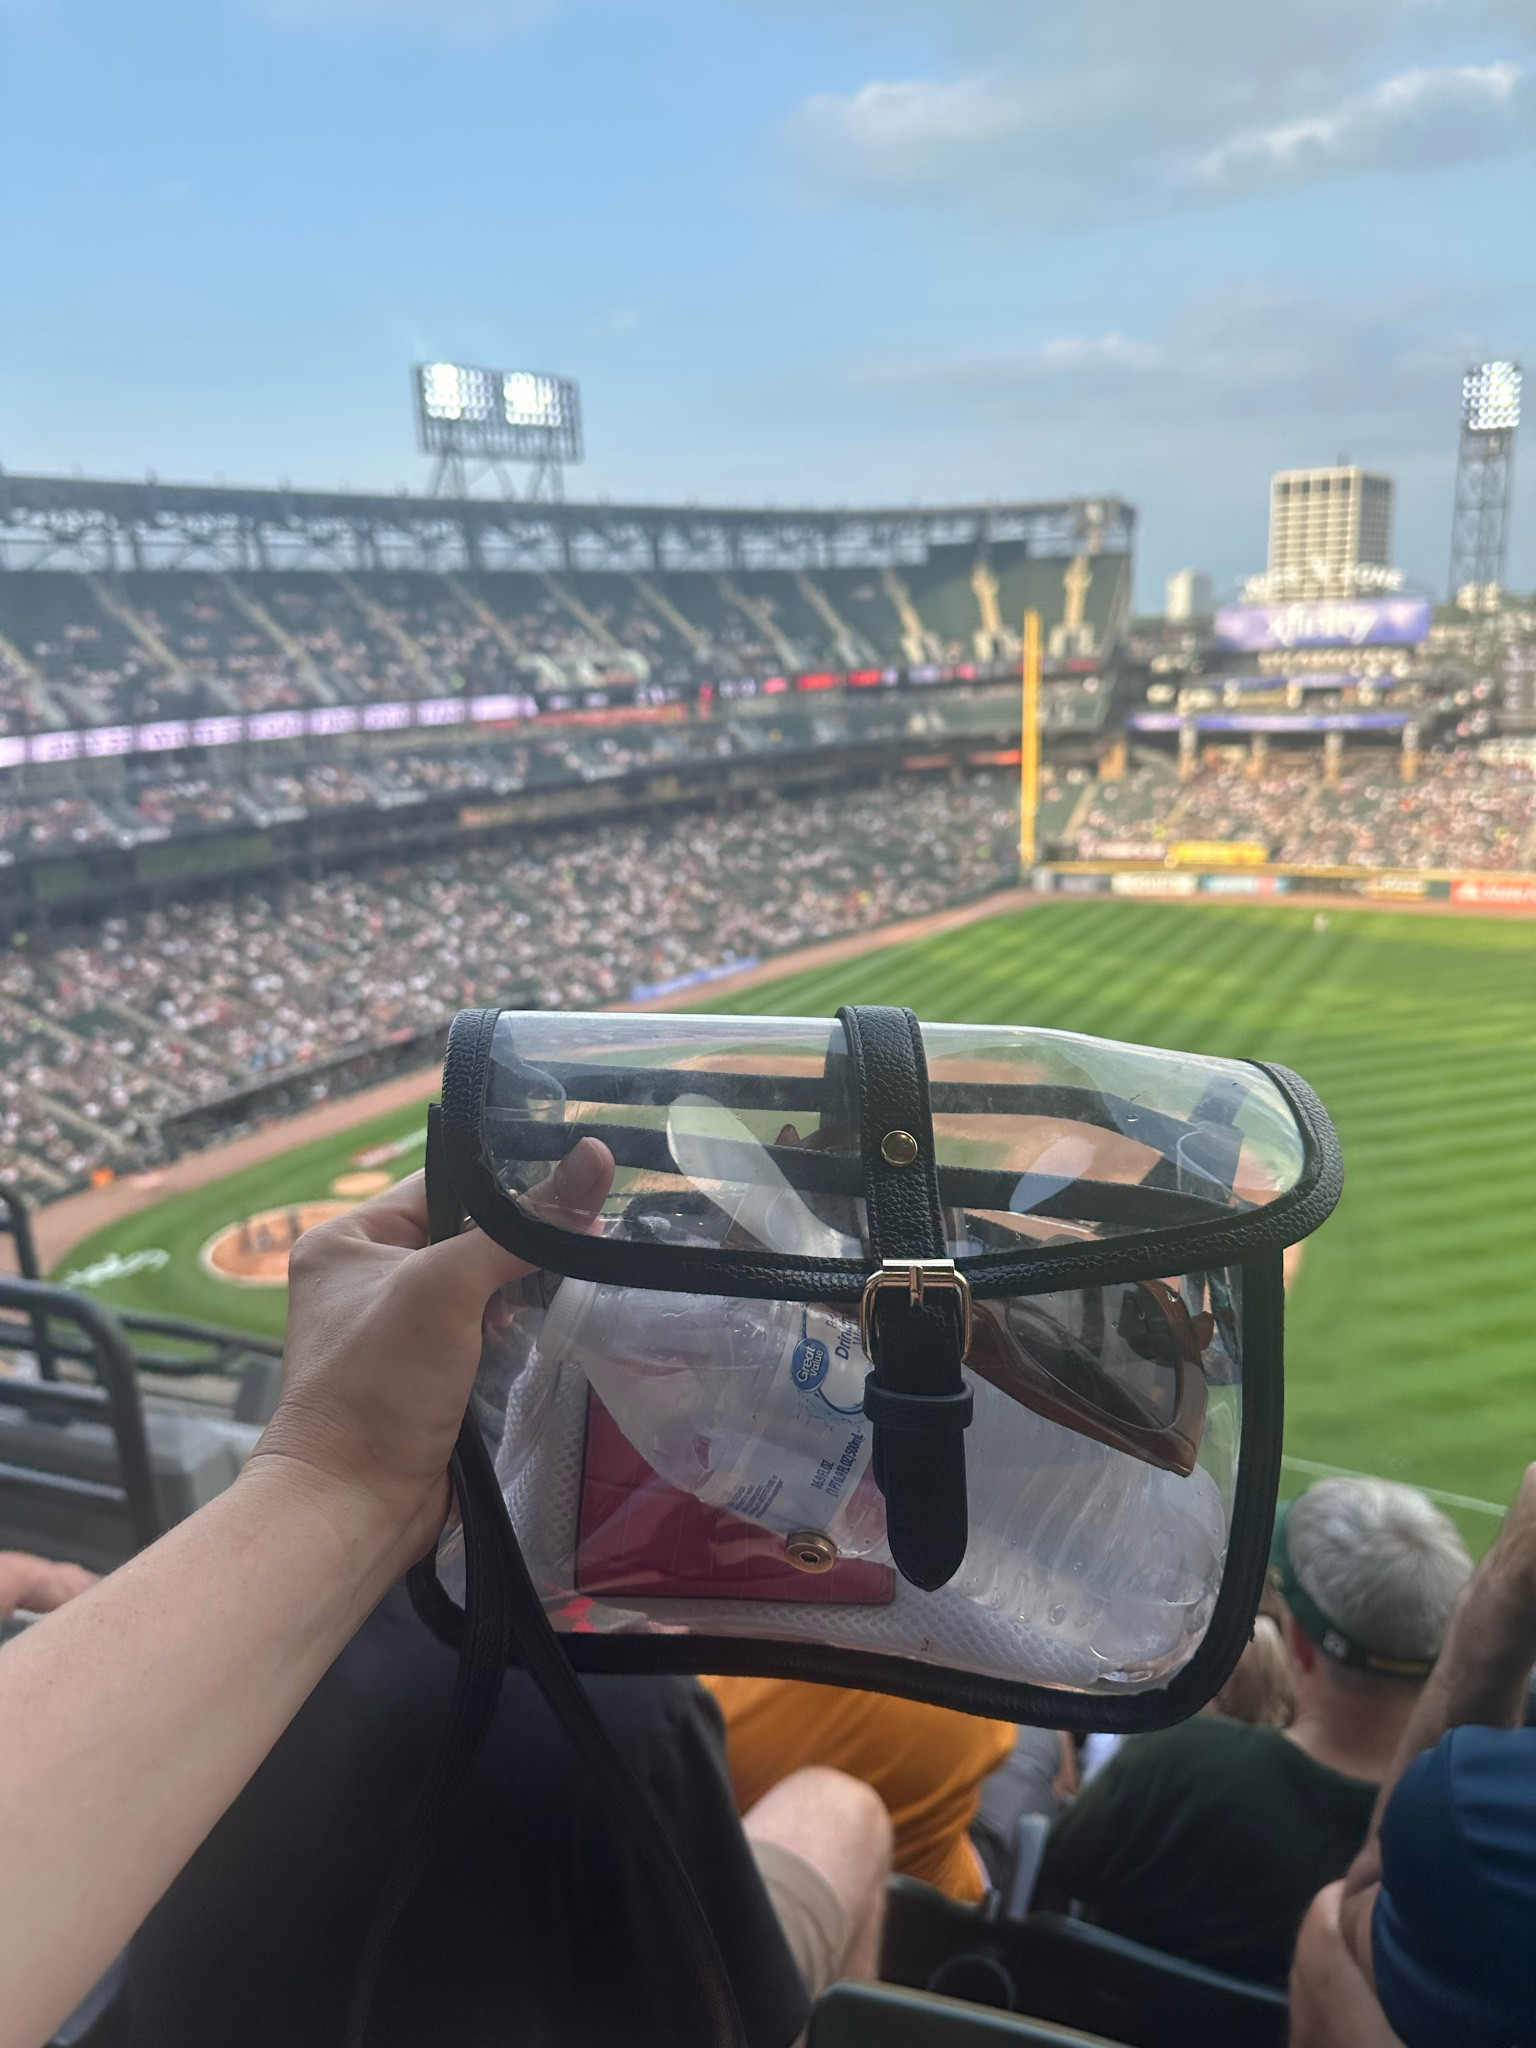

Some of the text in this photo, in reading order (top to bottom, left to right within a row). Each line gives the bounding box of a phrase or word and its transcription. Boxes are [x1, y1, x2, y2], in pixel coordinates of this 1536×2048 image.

[796, 1345, 816, 1382] Great
[809, 1349, 824, 1376] Value
[820, 1459, 834, 1470] OZ
